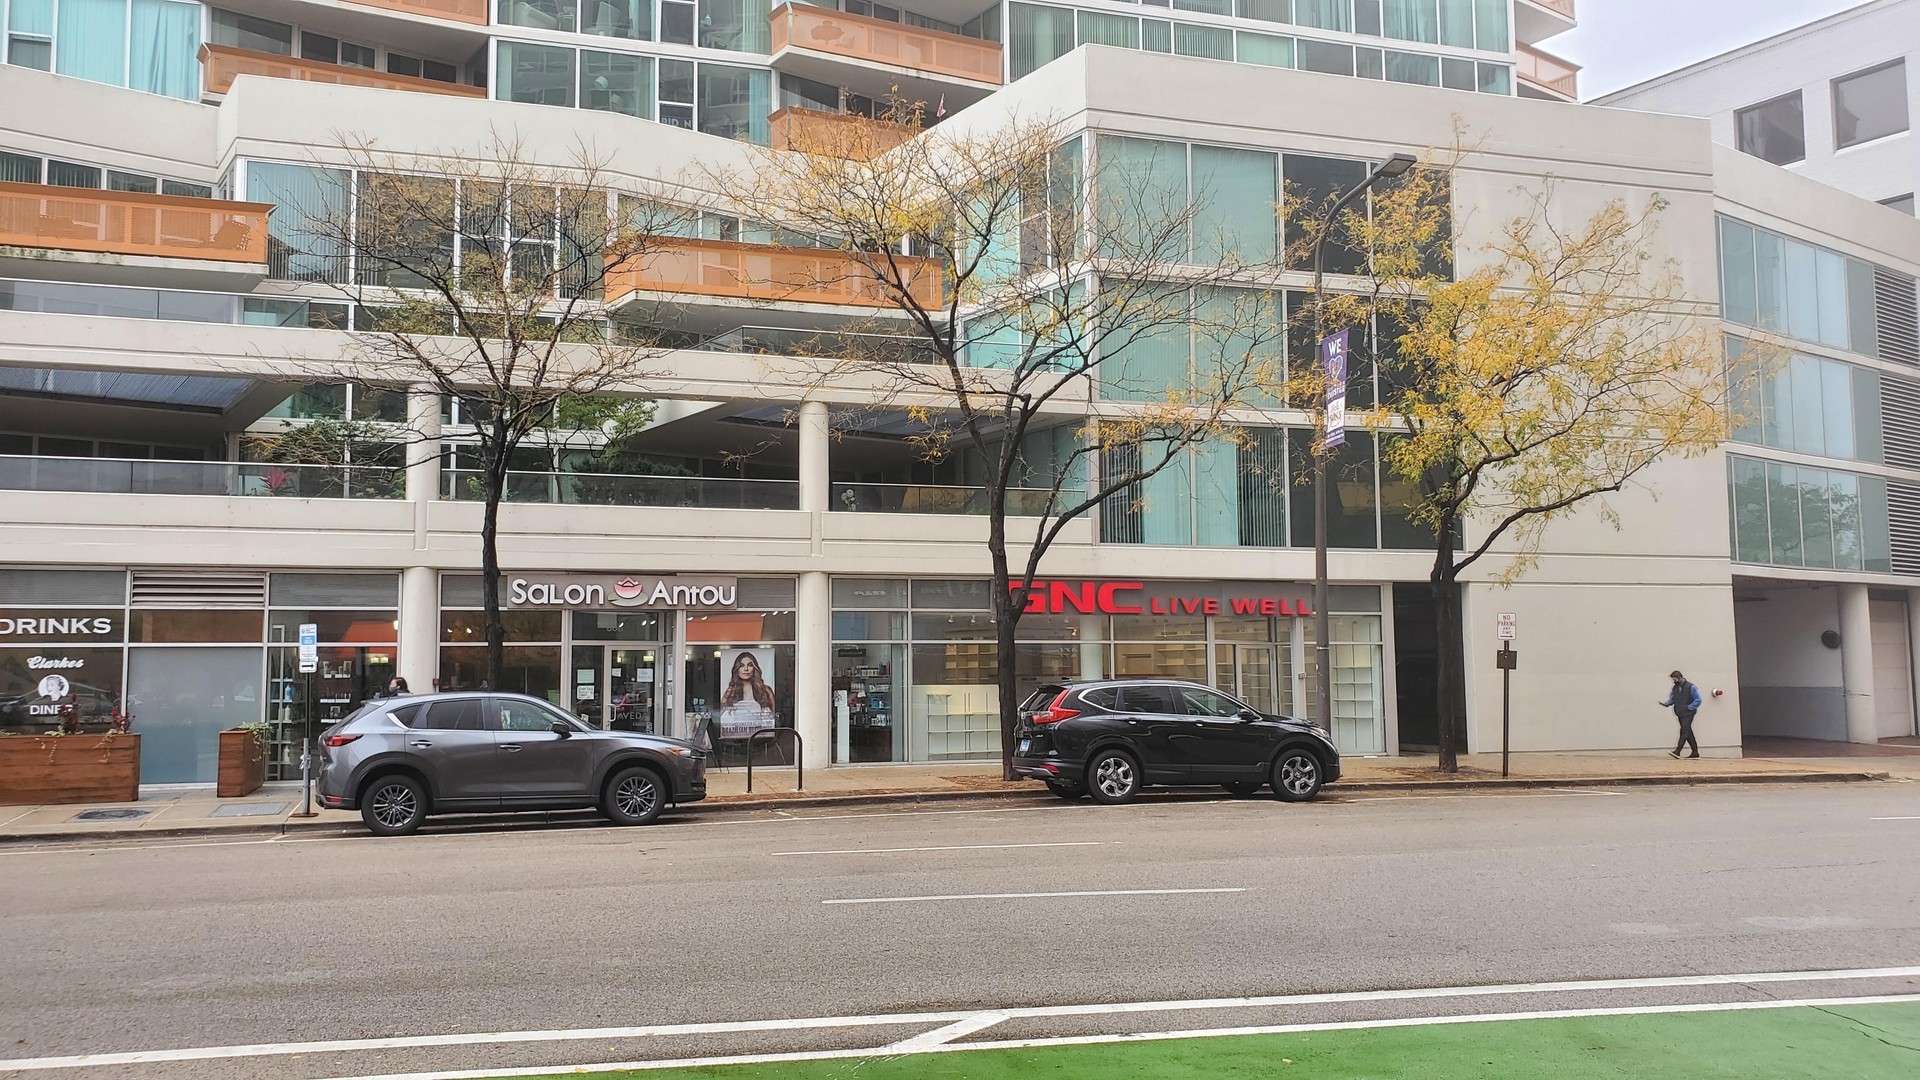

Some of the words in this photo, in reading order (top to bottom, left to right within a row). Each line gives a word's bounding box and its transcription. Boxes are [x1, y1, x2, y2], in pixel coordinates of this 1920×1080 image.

[661, 117, 692, 129] BIDN
[1328, 337, 1342, 357] WE
[648, 580, 736, 606] Antou
[1009, 581, 1144, 614] GNC
[1151, 597, 1221, 615] LIVE
[1231, 598, 1313, 616] WELL
[0, 617, 112, 635] DRINKS
